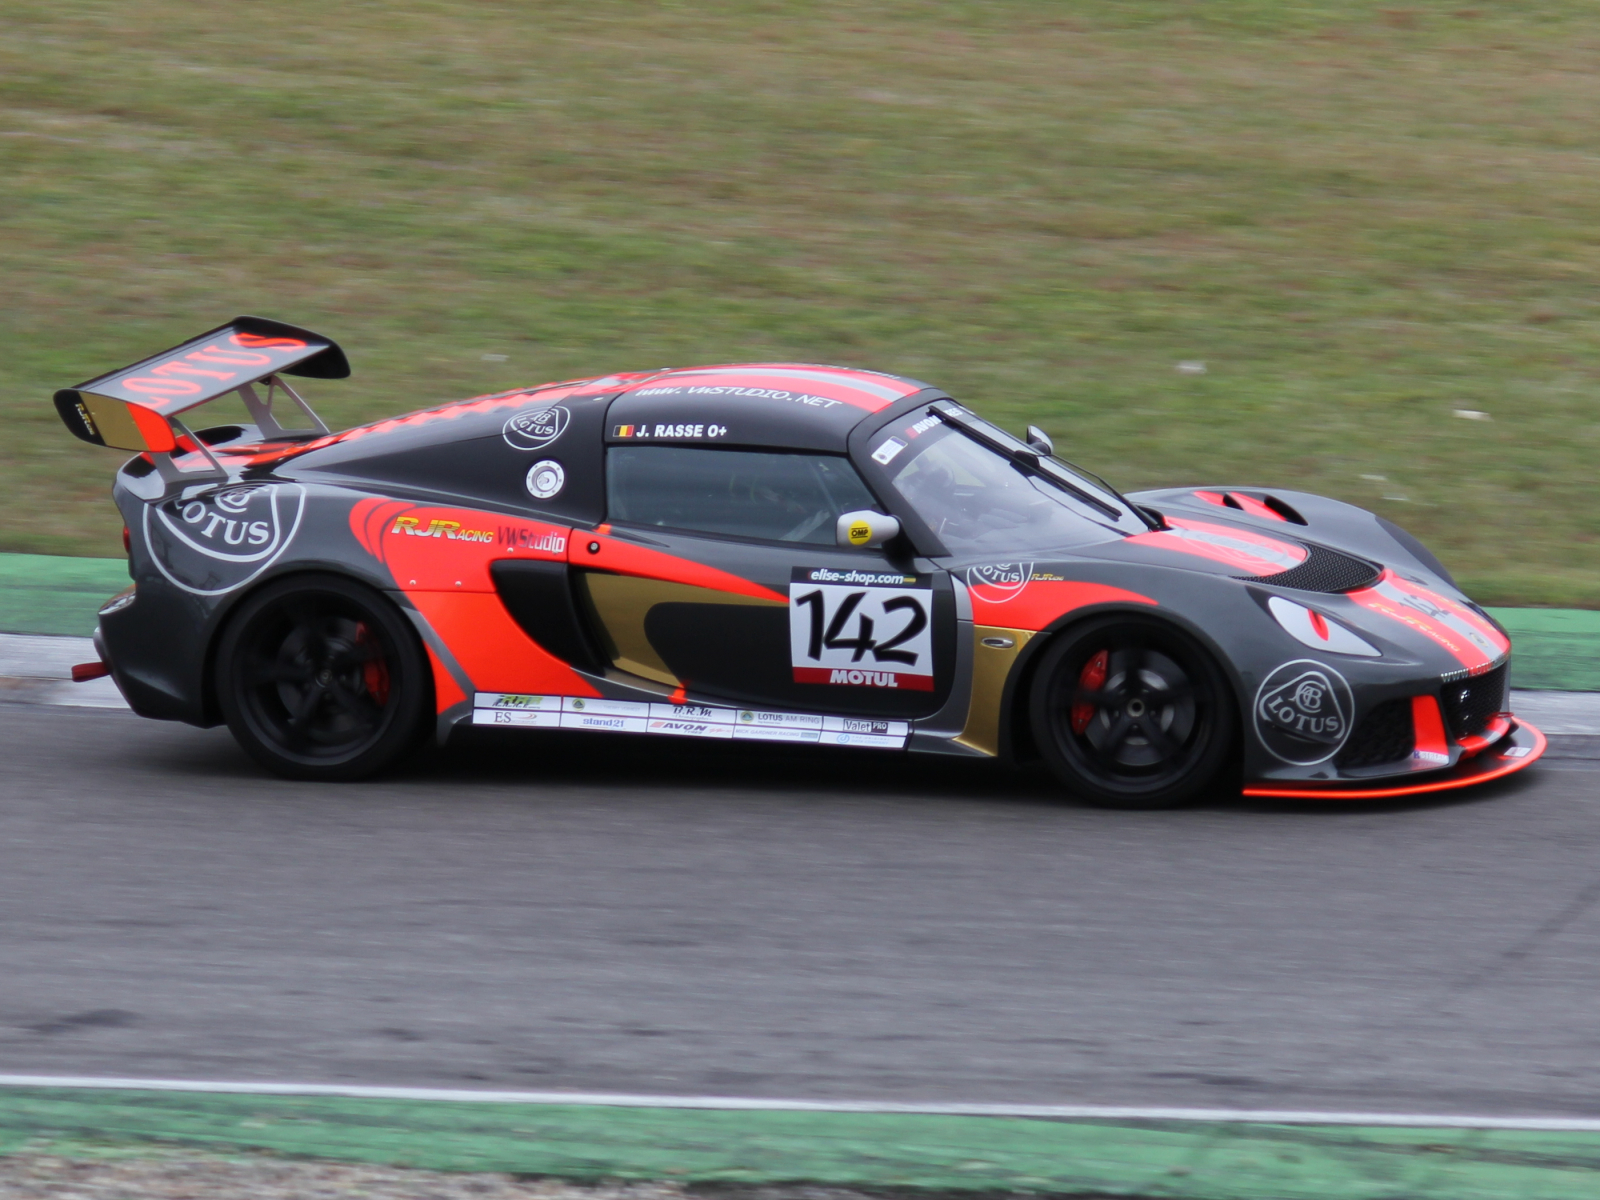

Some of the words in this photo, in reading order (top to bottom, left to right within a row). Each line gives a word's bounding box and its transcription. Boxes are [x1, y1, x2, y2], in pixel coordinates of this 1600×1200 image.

[516, 416, 554, 434] LOTUS
[636, 425, 649, 437] J.
[654, 425, 703, 438] RASSE
[851, 529, 869, 537] OMP
[810, 568, 904, 585] elise-shop.com
[979, 565, 1021, 583] OTUS
[795, 588, 928, 667] 142
[829, 669, 899, 687] MOTUL
[494, 711, 512, 723] ES
[582, 717, 625, 727] stand21
[757, 713, 783, 721] LOTUS
[799, 716, 820, 724] RING
[1267, 696, 1340, 733] LOTUS
[662, 722, 708, 731] AVON
